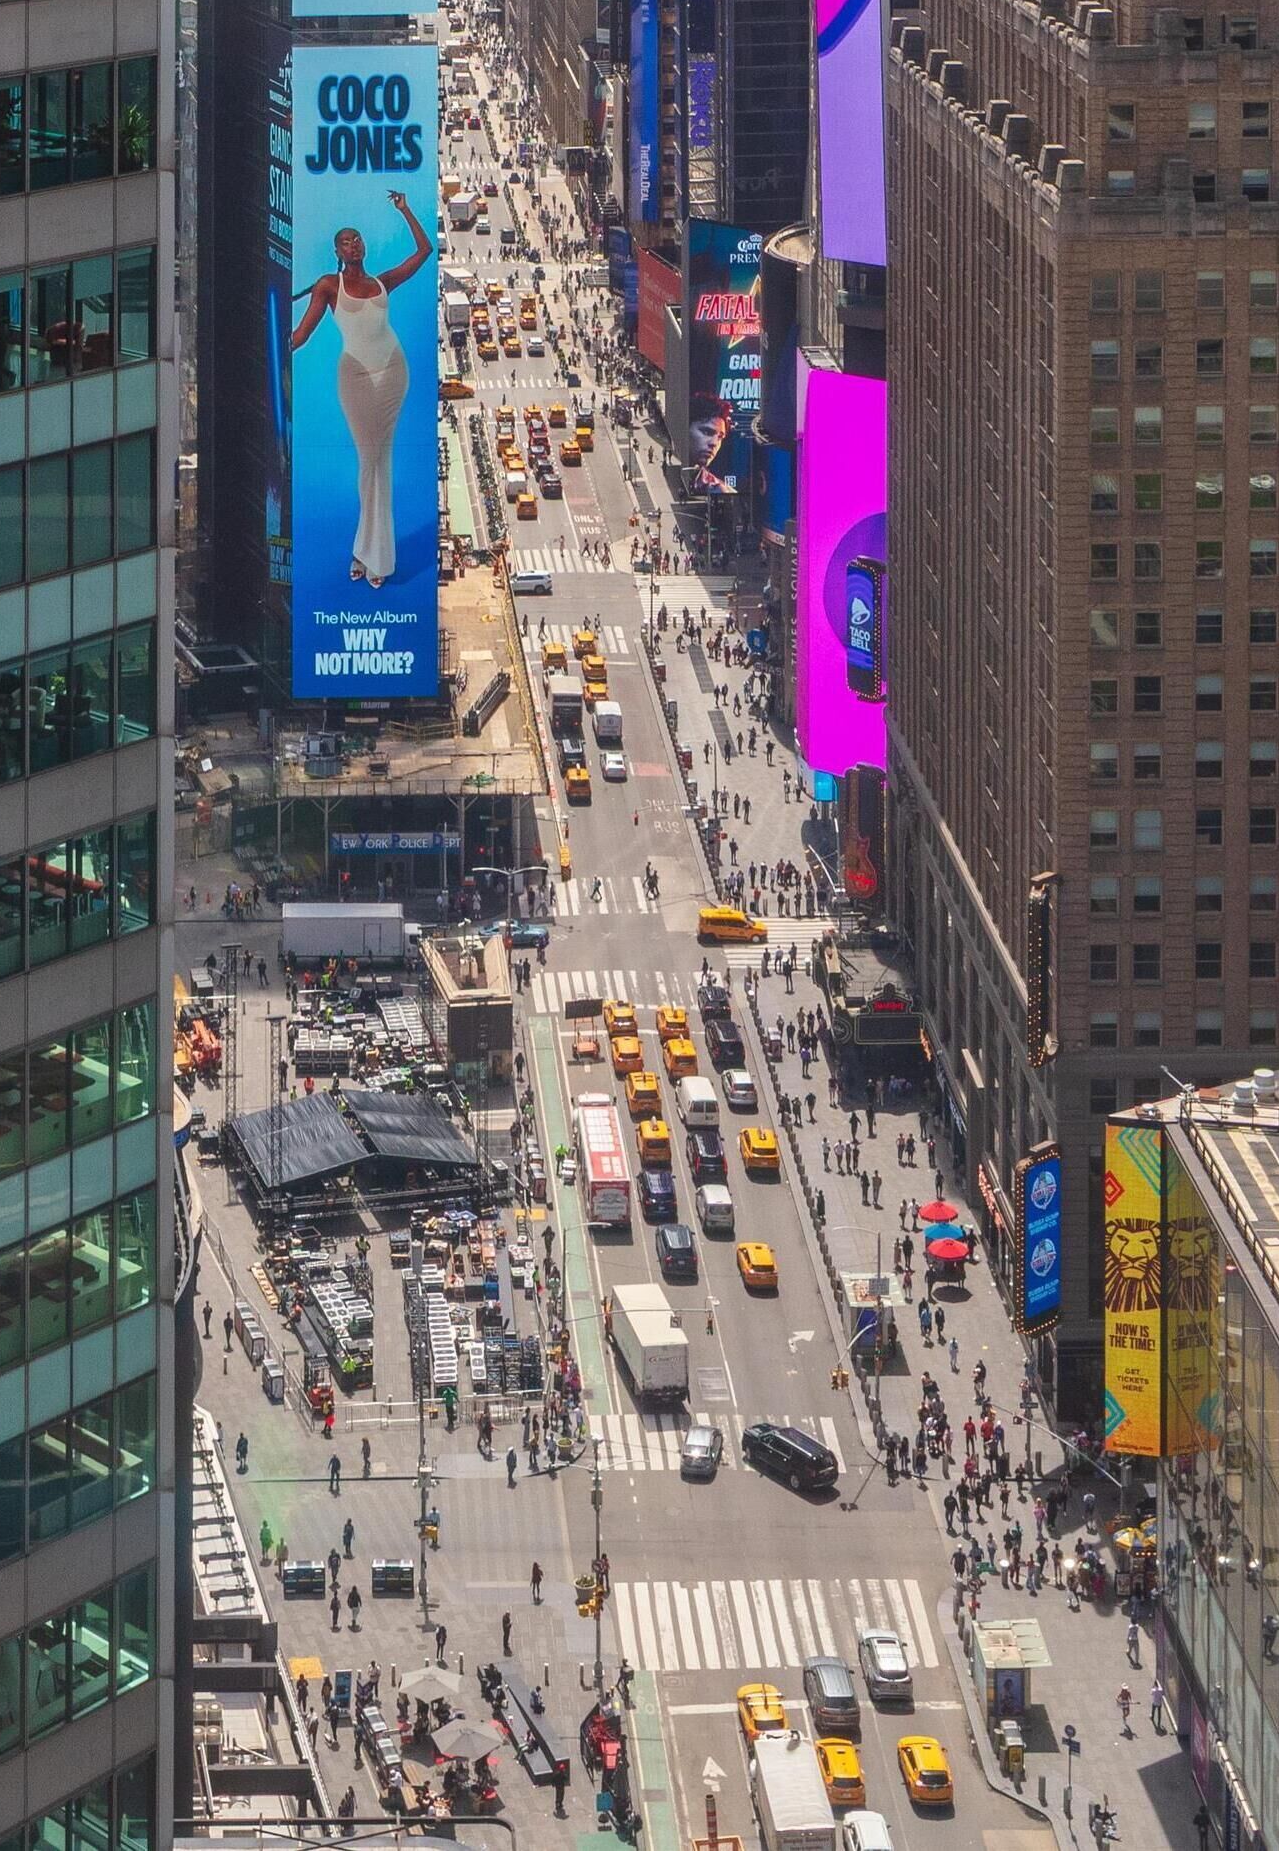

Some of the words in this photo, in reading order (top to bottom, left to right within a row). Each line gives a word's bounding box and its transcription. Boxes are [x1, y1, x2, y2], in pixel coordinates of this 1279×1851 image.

[318, 74, 410, 123] COCO
[305, 125, 423, 174] JONES
[695, 294, 760, 320] FATAL
[313, 611, 338, 624] The
[340, 611, 371, 624] New
[373, 611, 417, 623] Album
[343, 629, 387, 651] WHY
[849, 625, 871, 641] TACO
[851, 636, 871, 652] BELL
[315, 653, 351, 675] NOT
[352, 651, 415, 675] MORE?
[331, 834, 357, 849] NEW
[358, 833, 388, 849] YORK
[392, 834, 428, 848] POLICE
[1115, 1322, 1137, 1336] NOW
[1140, 1325, 1149, 1338] IS
[1109, 1334, 1128, 1349] THE
[1130, 1337, 1156, 1351] TIME!
[1125, 1367, 1140, 1375] GET
[1117, 1375, 1149, 1384] TICKETS
